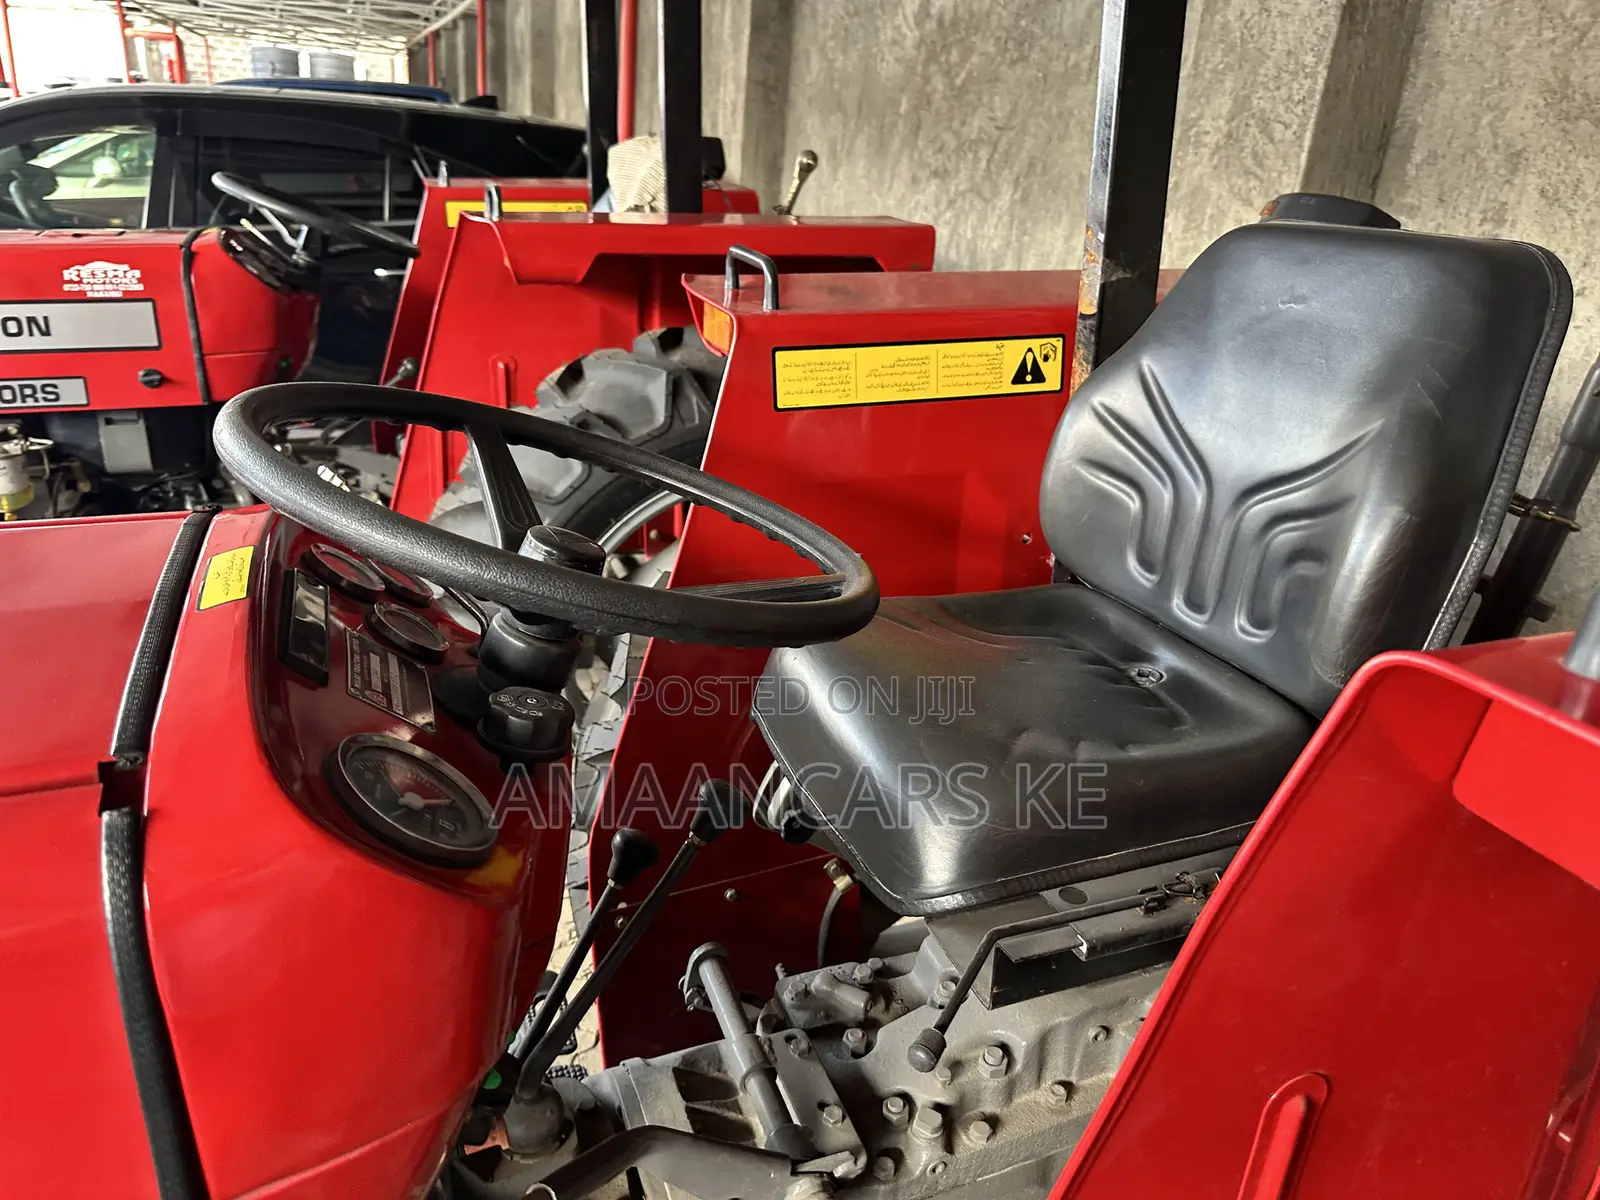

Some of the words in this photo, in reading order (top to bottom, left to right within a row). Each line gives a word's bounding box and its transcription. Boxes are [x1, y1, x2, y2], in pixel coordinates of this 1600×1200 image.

[63, 269, 141, 281] RESMA
[1, 315, 52, 337] ON
[0, 383, 61, 404] ORS
